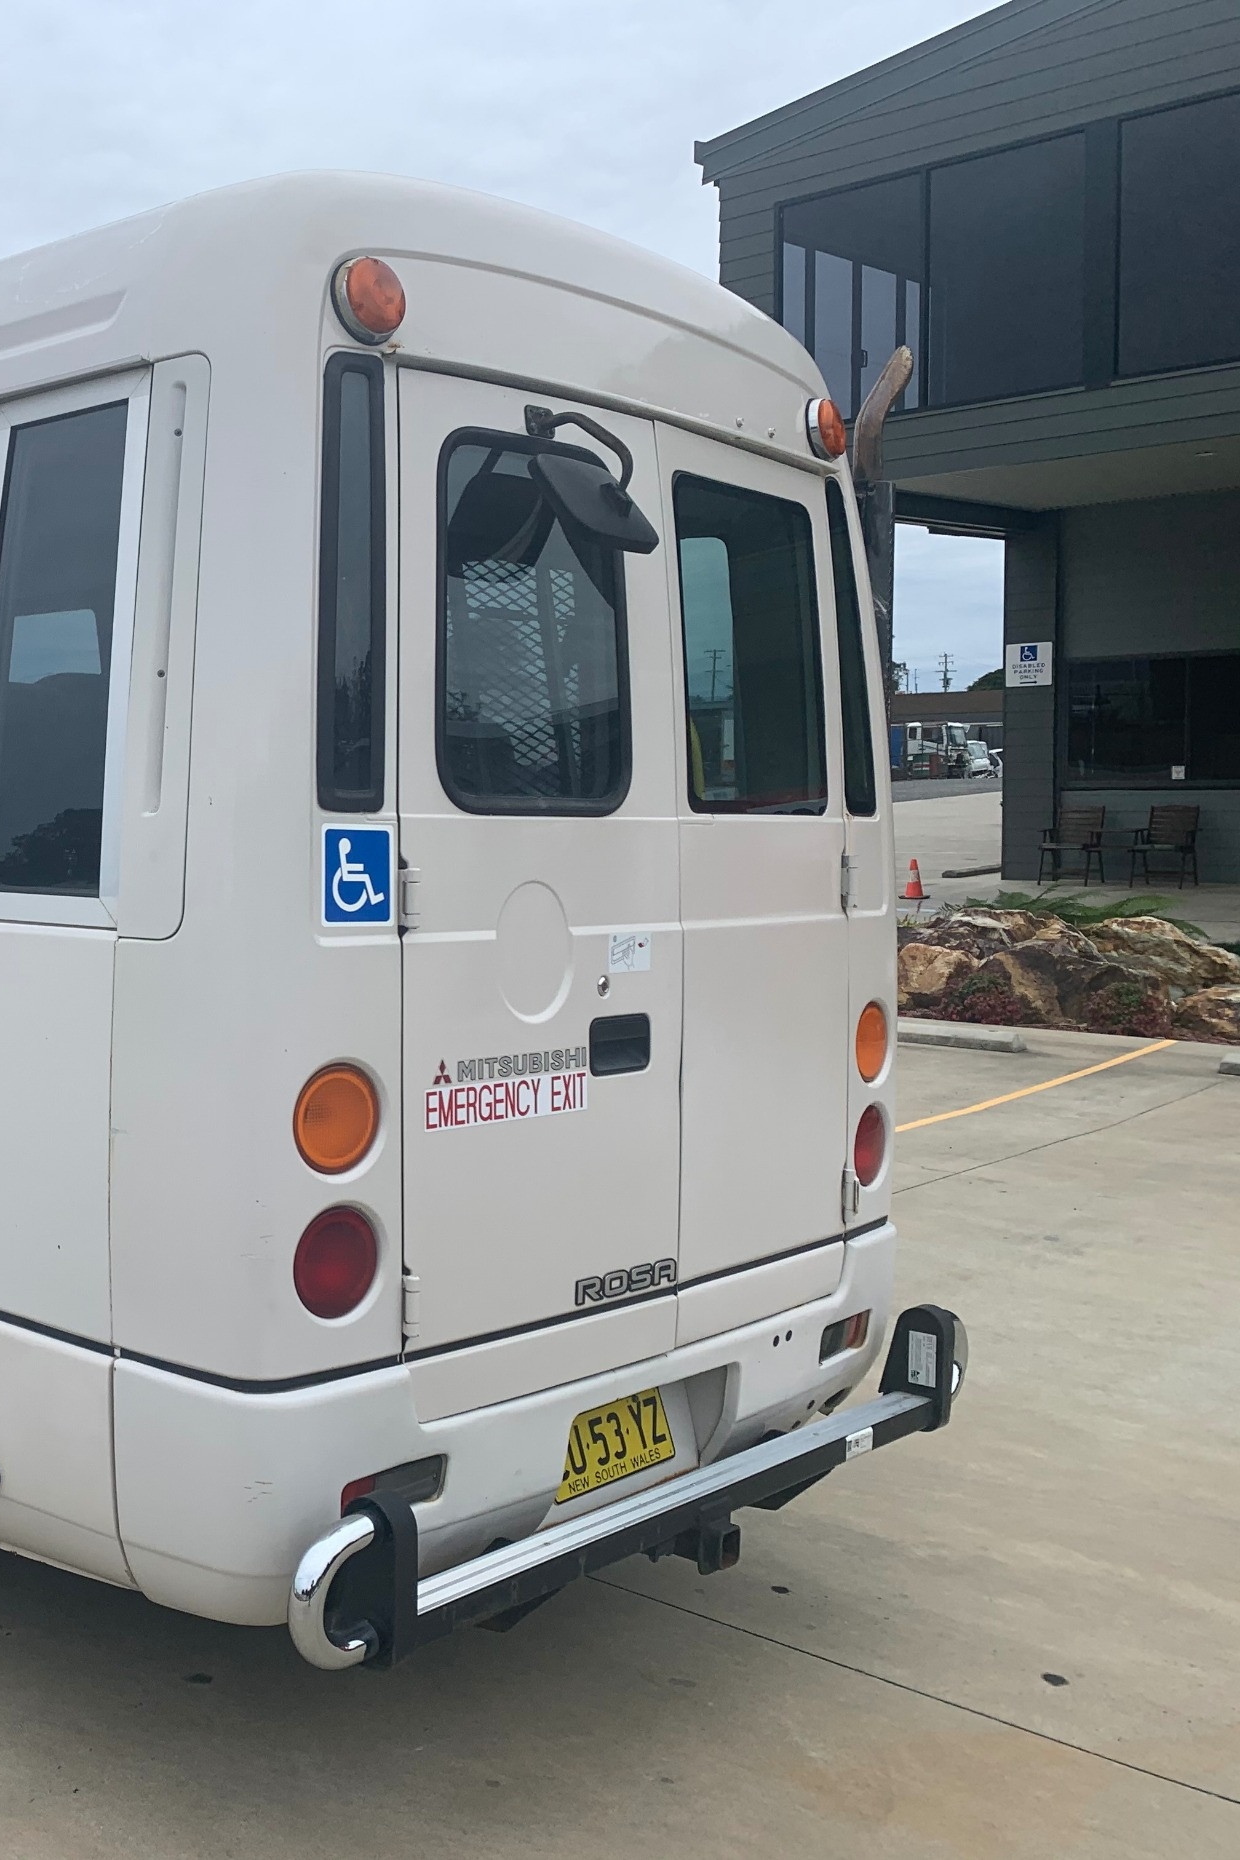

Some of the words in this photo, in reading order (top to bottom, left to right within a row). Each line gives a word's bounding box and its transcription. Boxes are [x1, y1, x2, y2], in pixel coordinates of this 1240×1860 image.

[457, 1046, 588, 1083] MITSUBISHI
[425, 1078, 541, 1130] EMERGENCY
[551, 1072, 587, 1112] EXIT
[574, 1257, 677, 1307] ROSA
[567, 1475, 590, 1494] NEW
[594, 1462, 628, 1484] SOUTH
[630, 1447, 661, 1469] WALES
